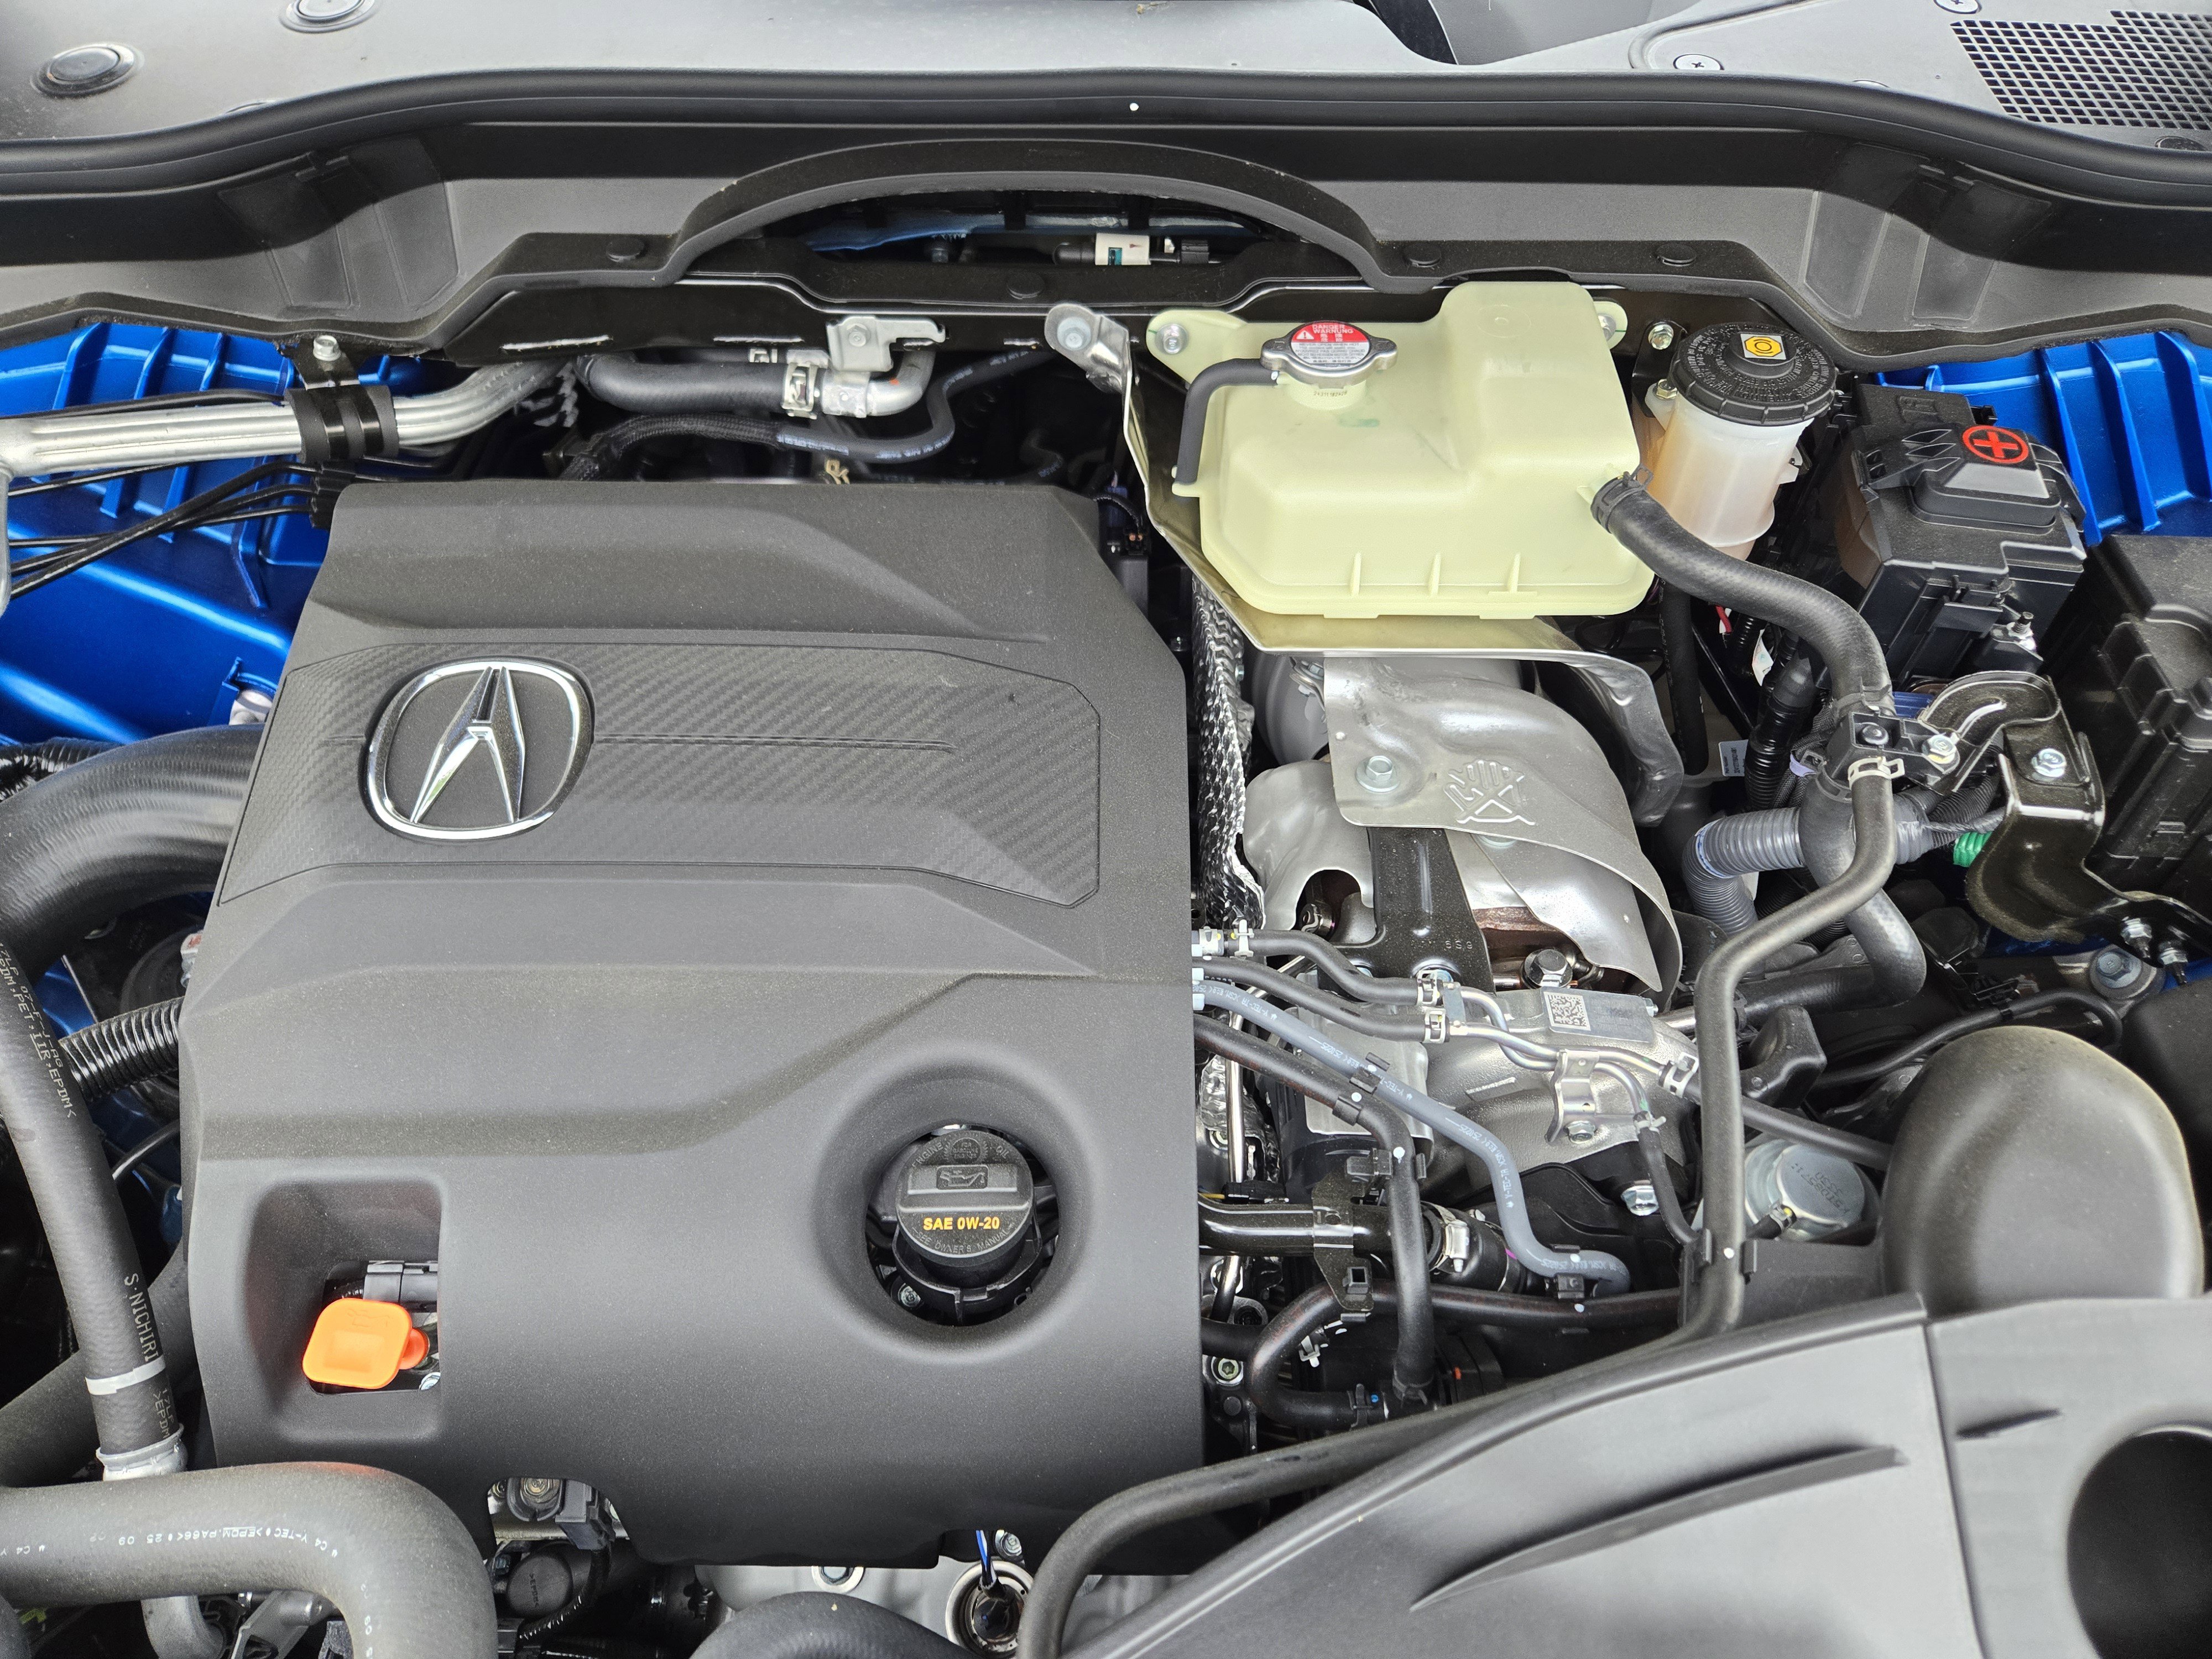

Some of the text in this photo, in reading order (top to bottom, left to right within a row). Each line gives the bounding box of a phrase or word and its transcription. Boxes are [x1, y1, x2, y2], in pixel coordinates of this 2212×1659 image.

[912, 1141, 1010, 1168] ENGINE OIL
[923, 1217, 1000, 1231] SAE 0W-20
[916, 1232, 932, 1246] SEE
[977, 1230, 1010, 1250] MANUAL
[118, 1535, 135, 1546] 09
[147, 1532, 163, 1544] 25
[274, 1526, 308, 1544] Y-TEC
[314, 1536, 328, 1551] C4
